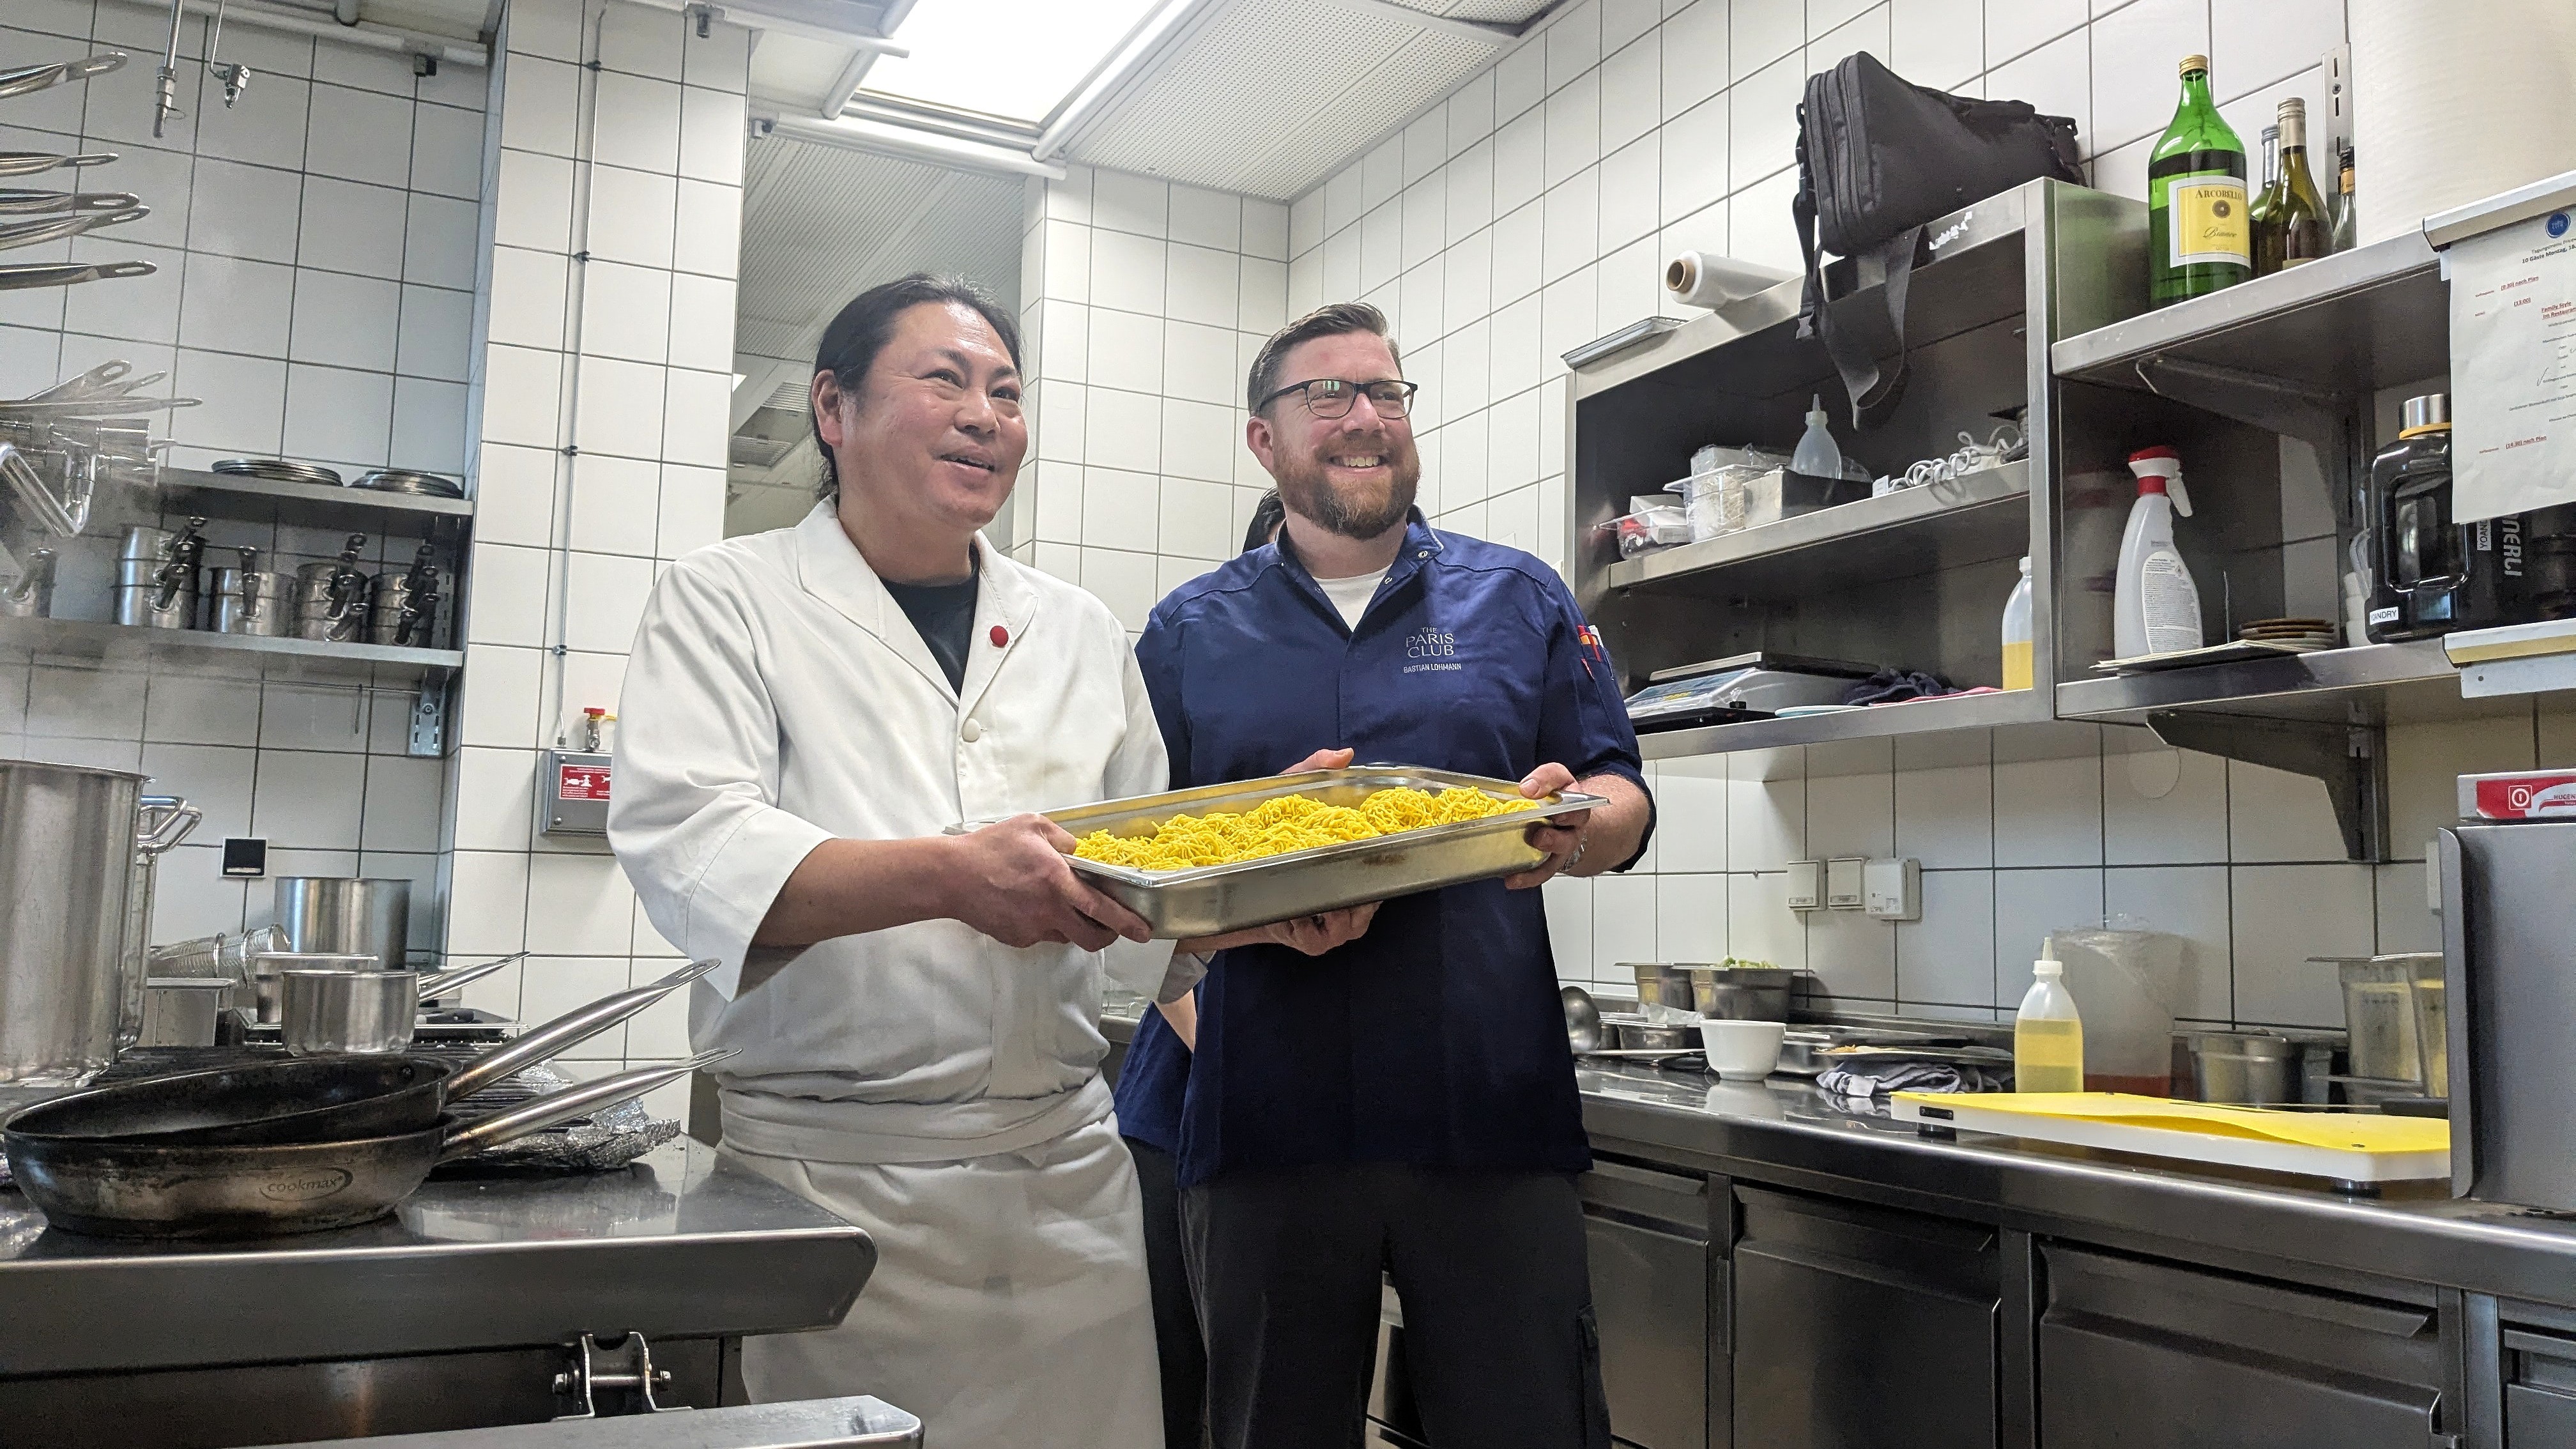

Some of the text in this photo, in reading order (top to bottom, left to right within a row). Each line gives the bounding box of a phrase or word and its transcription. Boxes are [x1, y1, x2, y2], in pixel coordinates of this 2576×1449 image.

[2195, 189, 2242, 201] ARCOBELLO
[1406, 633, 1455, 647] PARIS
[1407, 645, 1455, 659] CLUB
[1403, 662, 1462, 673] BASTIAN LOHMANN
[268, 1177, 337, 1192] cookmax
